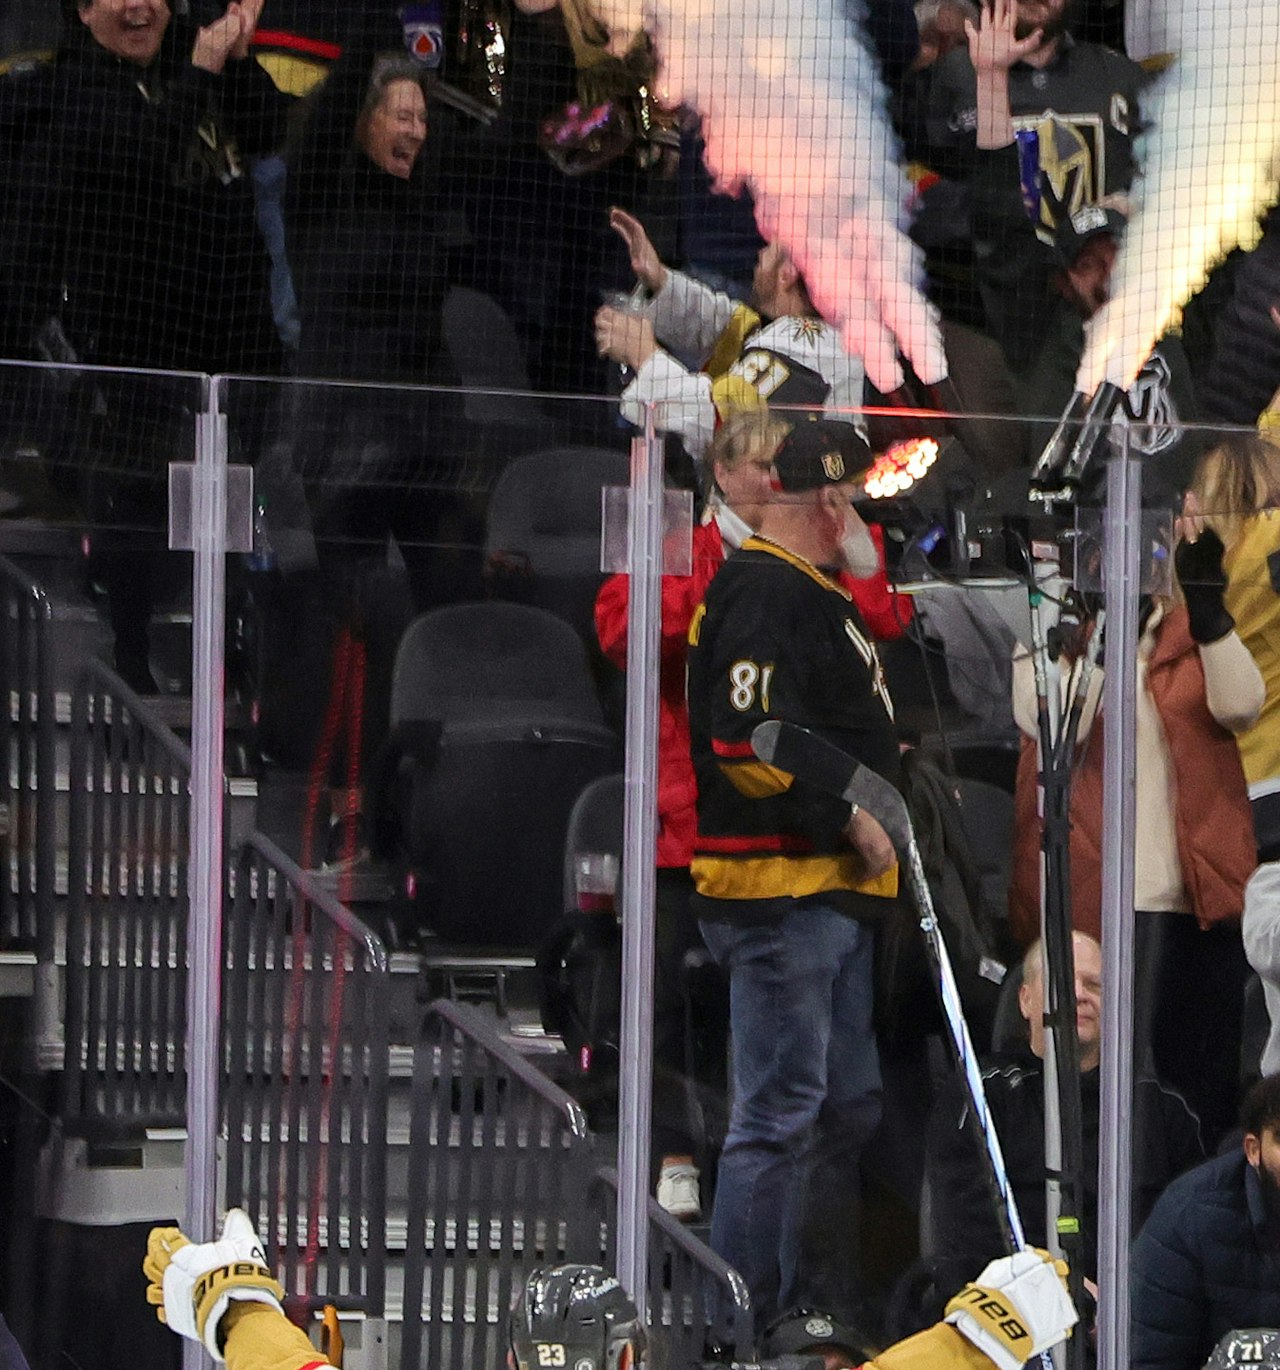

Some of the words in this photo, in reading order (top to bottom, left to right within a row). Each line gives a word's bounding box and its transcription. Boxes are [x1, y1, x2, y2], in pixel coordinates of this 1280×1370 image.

[730, 660, 775, 714] 81
[537, 1344, 566, 1367] 23
[1241, 1340, 1264, 1361] 71
